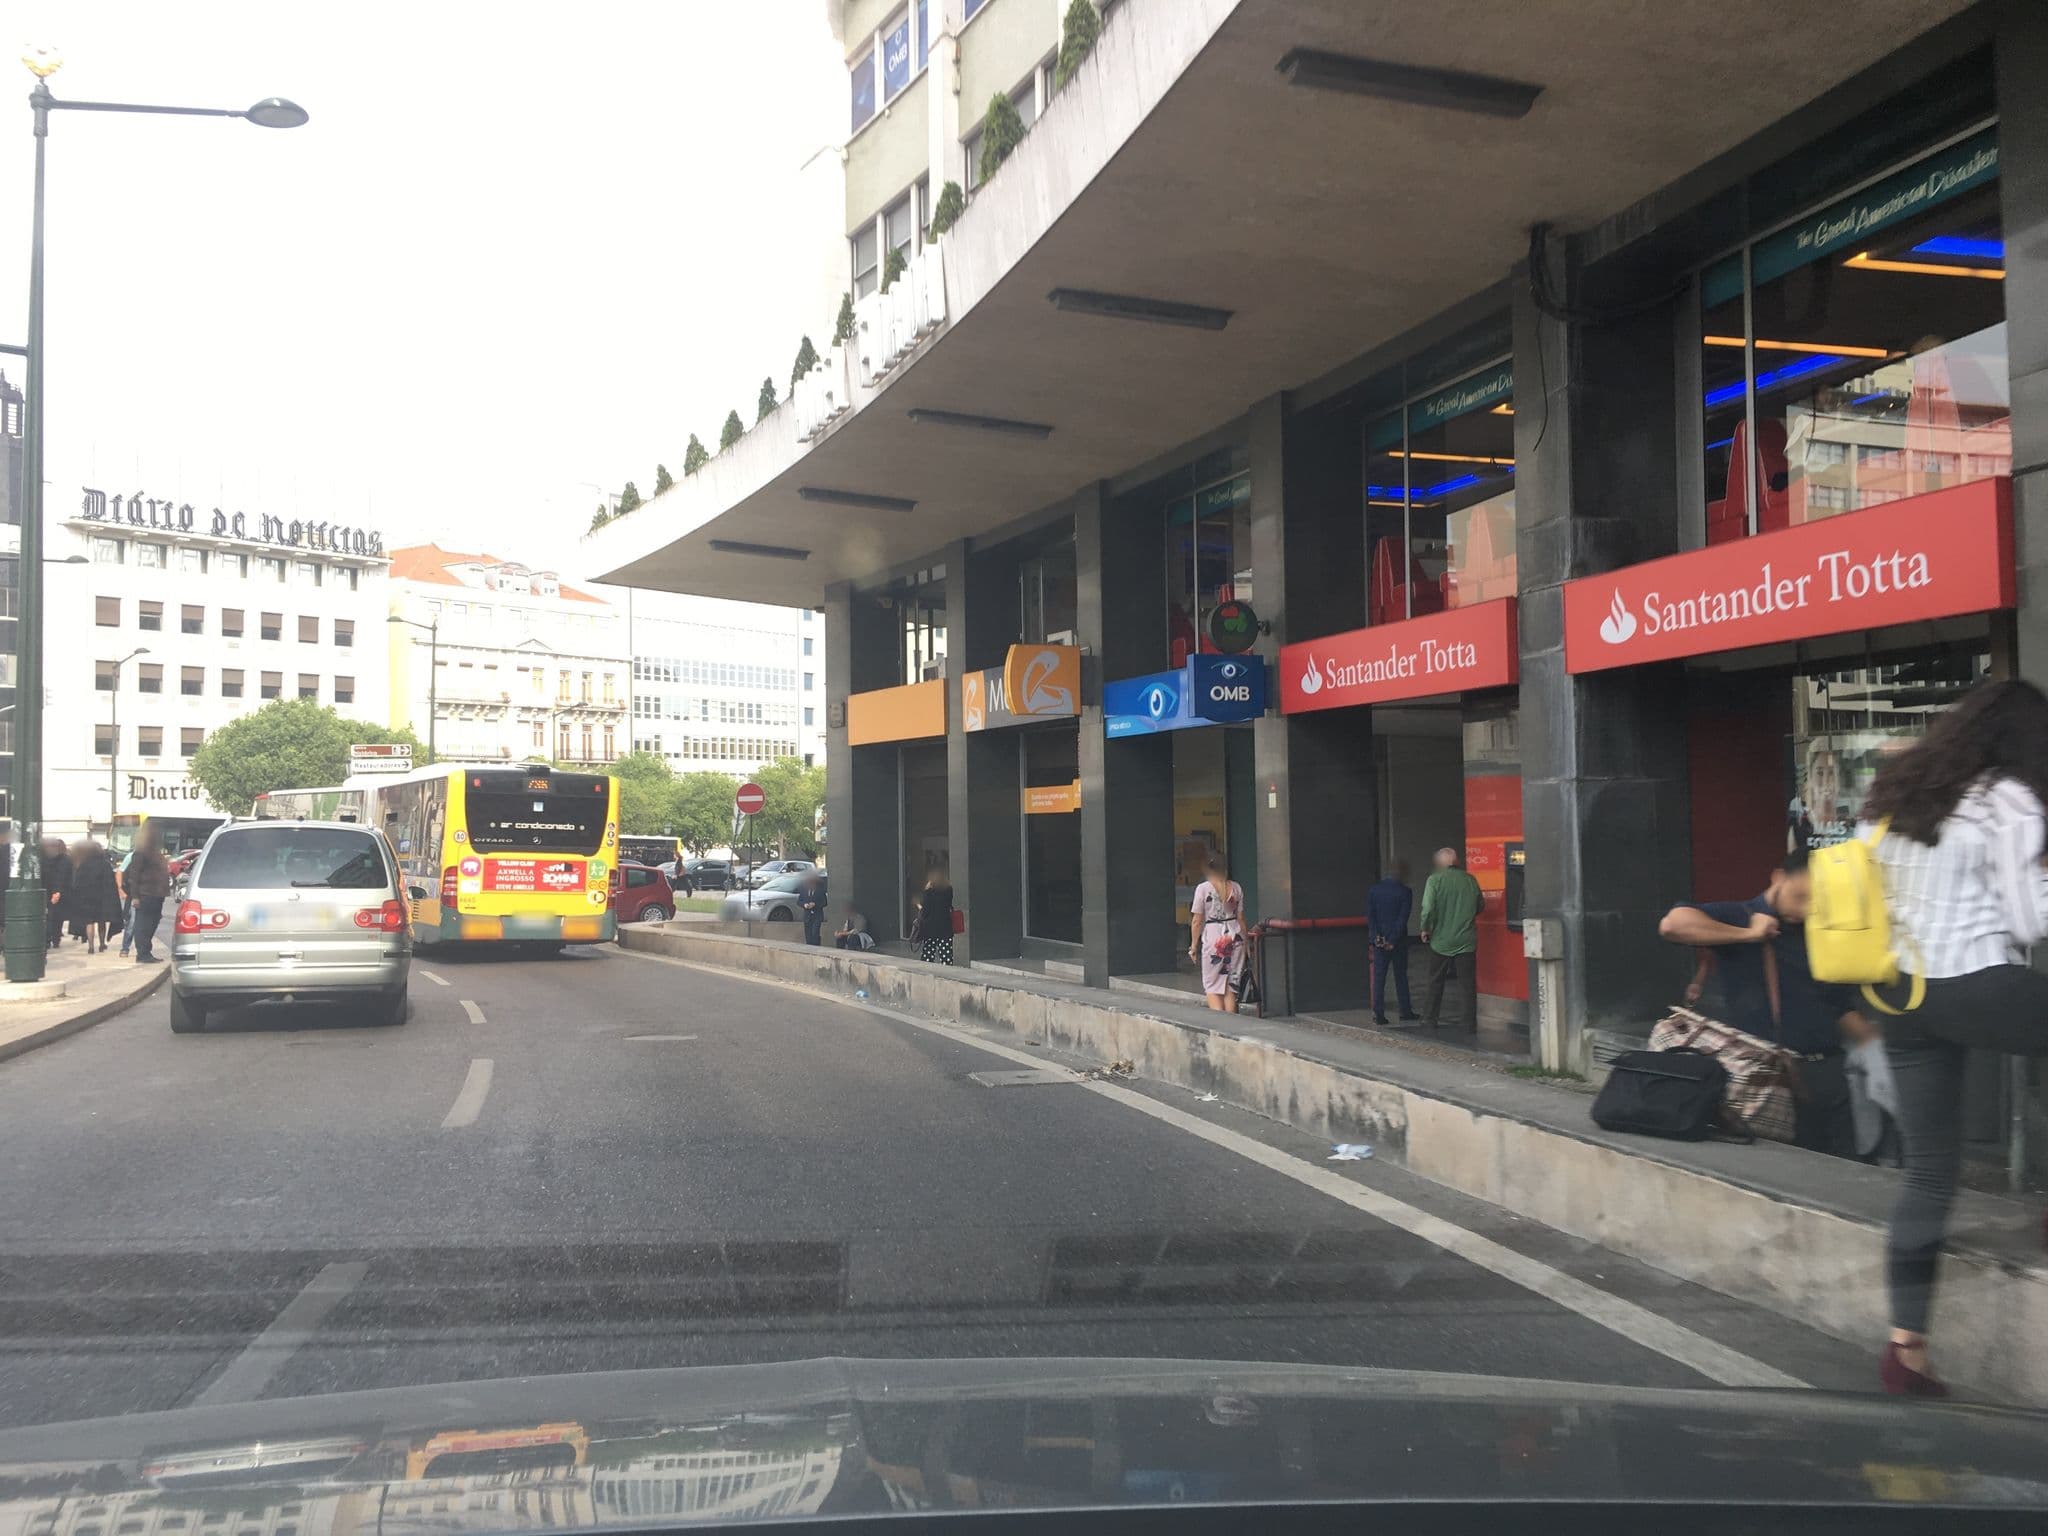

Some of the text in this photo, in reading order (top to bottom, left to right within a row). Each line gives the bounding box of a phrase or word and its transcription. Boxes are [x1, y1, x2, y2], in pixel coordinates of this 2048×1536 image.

[212, 507, 246, 539] de
[1643, 549, 1932, 636] Santander Totta
[1326, 639, 1477, 689] Santander Totta
[1210, 685, 1250, 701] OMB
